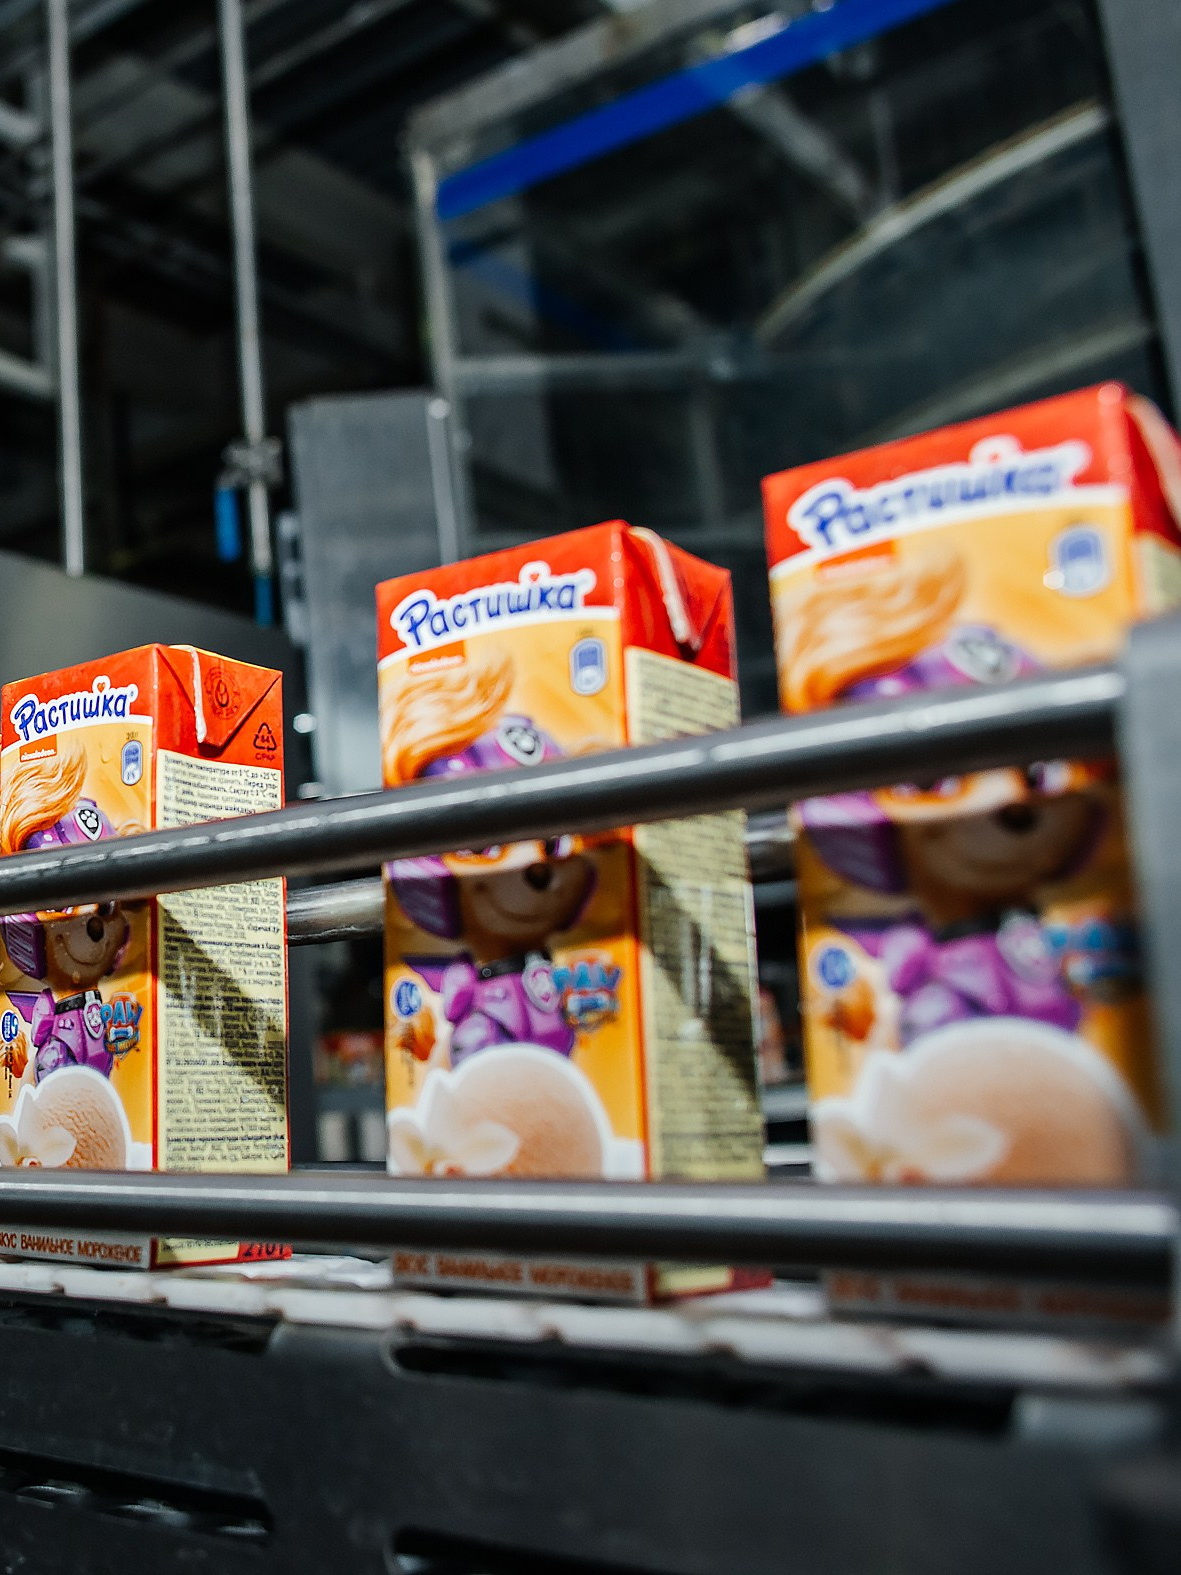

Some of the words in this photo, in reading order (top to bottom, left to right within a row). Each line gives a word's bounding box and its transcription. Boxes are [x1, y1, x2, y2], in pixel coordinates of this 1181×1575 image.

[400, 584, 576, 645] Растишка
[14, 694, 128, 741] Растишка
[100, 1000, 143, 1024] PAW
[21, 1232, 75, 1257] ВАНИЛЬНОЕ
[77, 1239, 142, 1263] МОРОЖЕНОЕ
